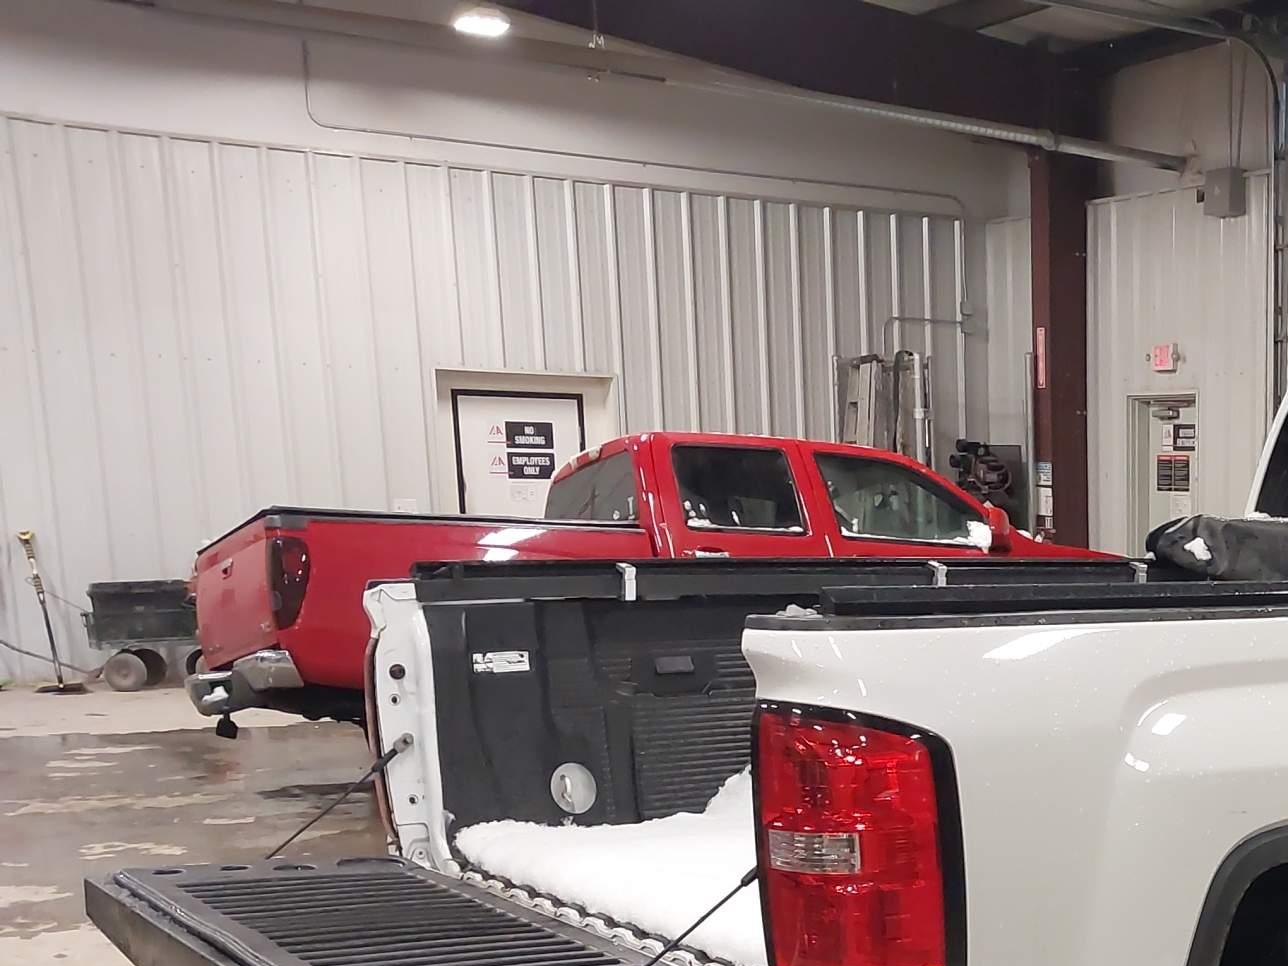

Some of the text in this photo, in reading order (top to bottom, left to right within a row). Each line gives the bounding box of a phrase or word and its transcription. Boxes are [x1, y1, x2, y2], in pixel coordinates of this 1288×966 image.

[524, 425, 535, 435] NO
[514, 435, 546, 445] SMOKING
[511, 456, 551, 465] EMPLOYEES
[523, 466, 541, 475] ONLY
